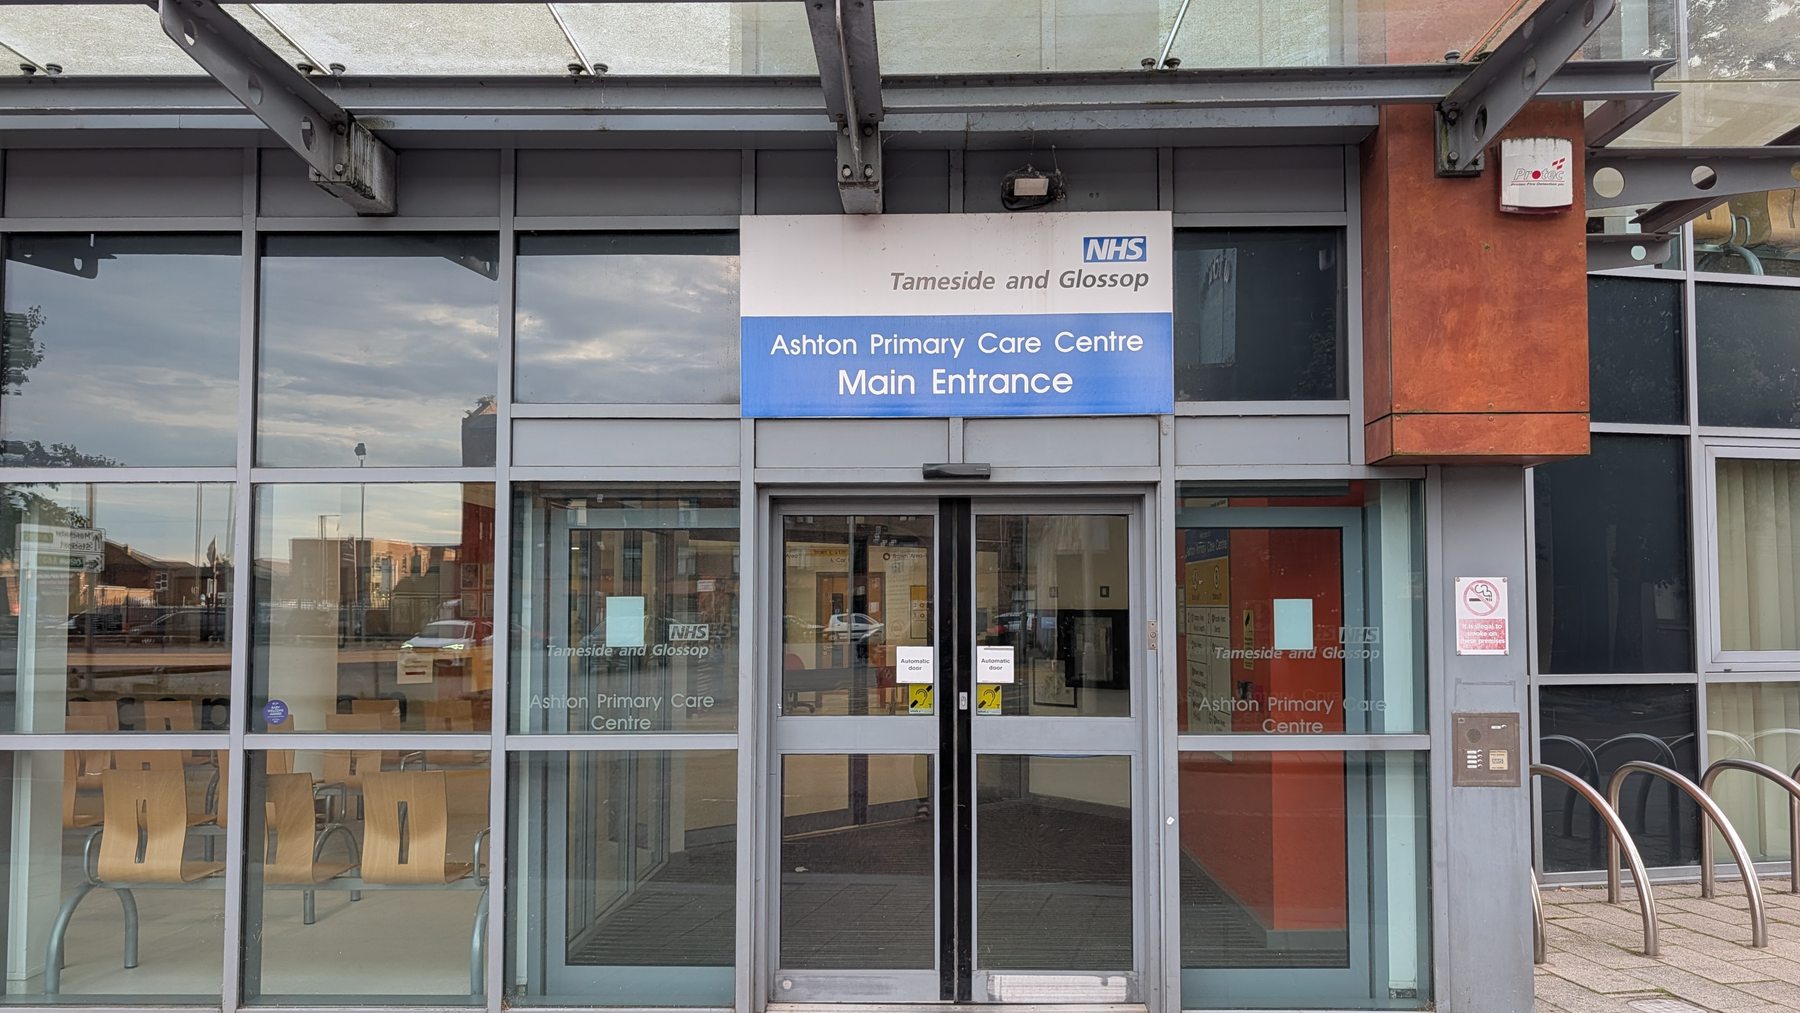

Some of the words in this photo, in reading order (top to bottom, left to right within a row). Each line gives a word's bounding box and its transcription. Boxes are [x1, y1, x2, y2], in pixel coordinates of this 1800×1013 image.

[1513, 167, 1564, 181] Protec
[1085, 237, 1146, 262] NHS
[890, 271, 995, 291] Tameside
[1006, 269, 1049, 290] and
[1059, 268, 1149, 292] Glossop
[770, 333, 858, 356] Ashton
[870, 332, 965, 359] Primary
[978, 331, 1042, 354] Care
[1054, 330, 1145, 353] Centre
[838, 368, 916, 396] Main
[931, 368, 1074, 395] Entrance
[670, 625, 708, 640] NHS
[1340, 627, 1378, 643] NHS
[546, 645, 612, 657] Tameside
[619, 645, 647, 657] and
[653, 644, 709, 659] Glossop
[1214, 647, 1282, 659] Tameside
[1288, 646, 1316, 659] and
[1322, 646, 1380, 662] Glossop
[529, 694, 588, 710] Ashton
[597, 693, 662, 711] Primary
[670, 693, 715, 709] Care
[1199, 697, 1259, 712] Ashton
[1268, 697, 1334, 715] Primary
[1343, 698, 1387, 712] Care
[591, 715, 651, 731] Centre
[1262, 717, 1324, 734] Centre
